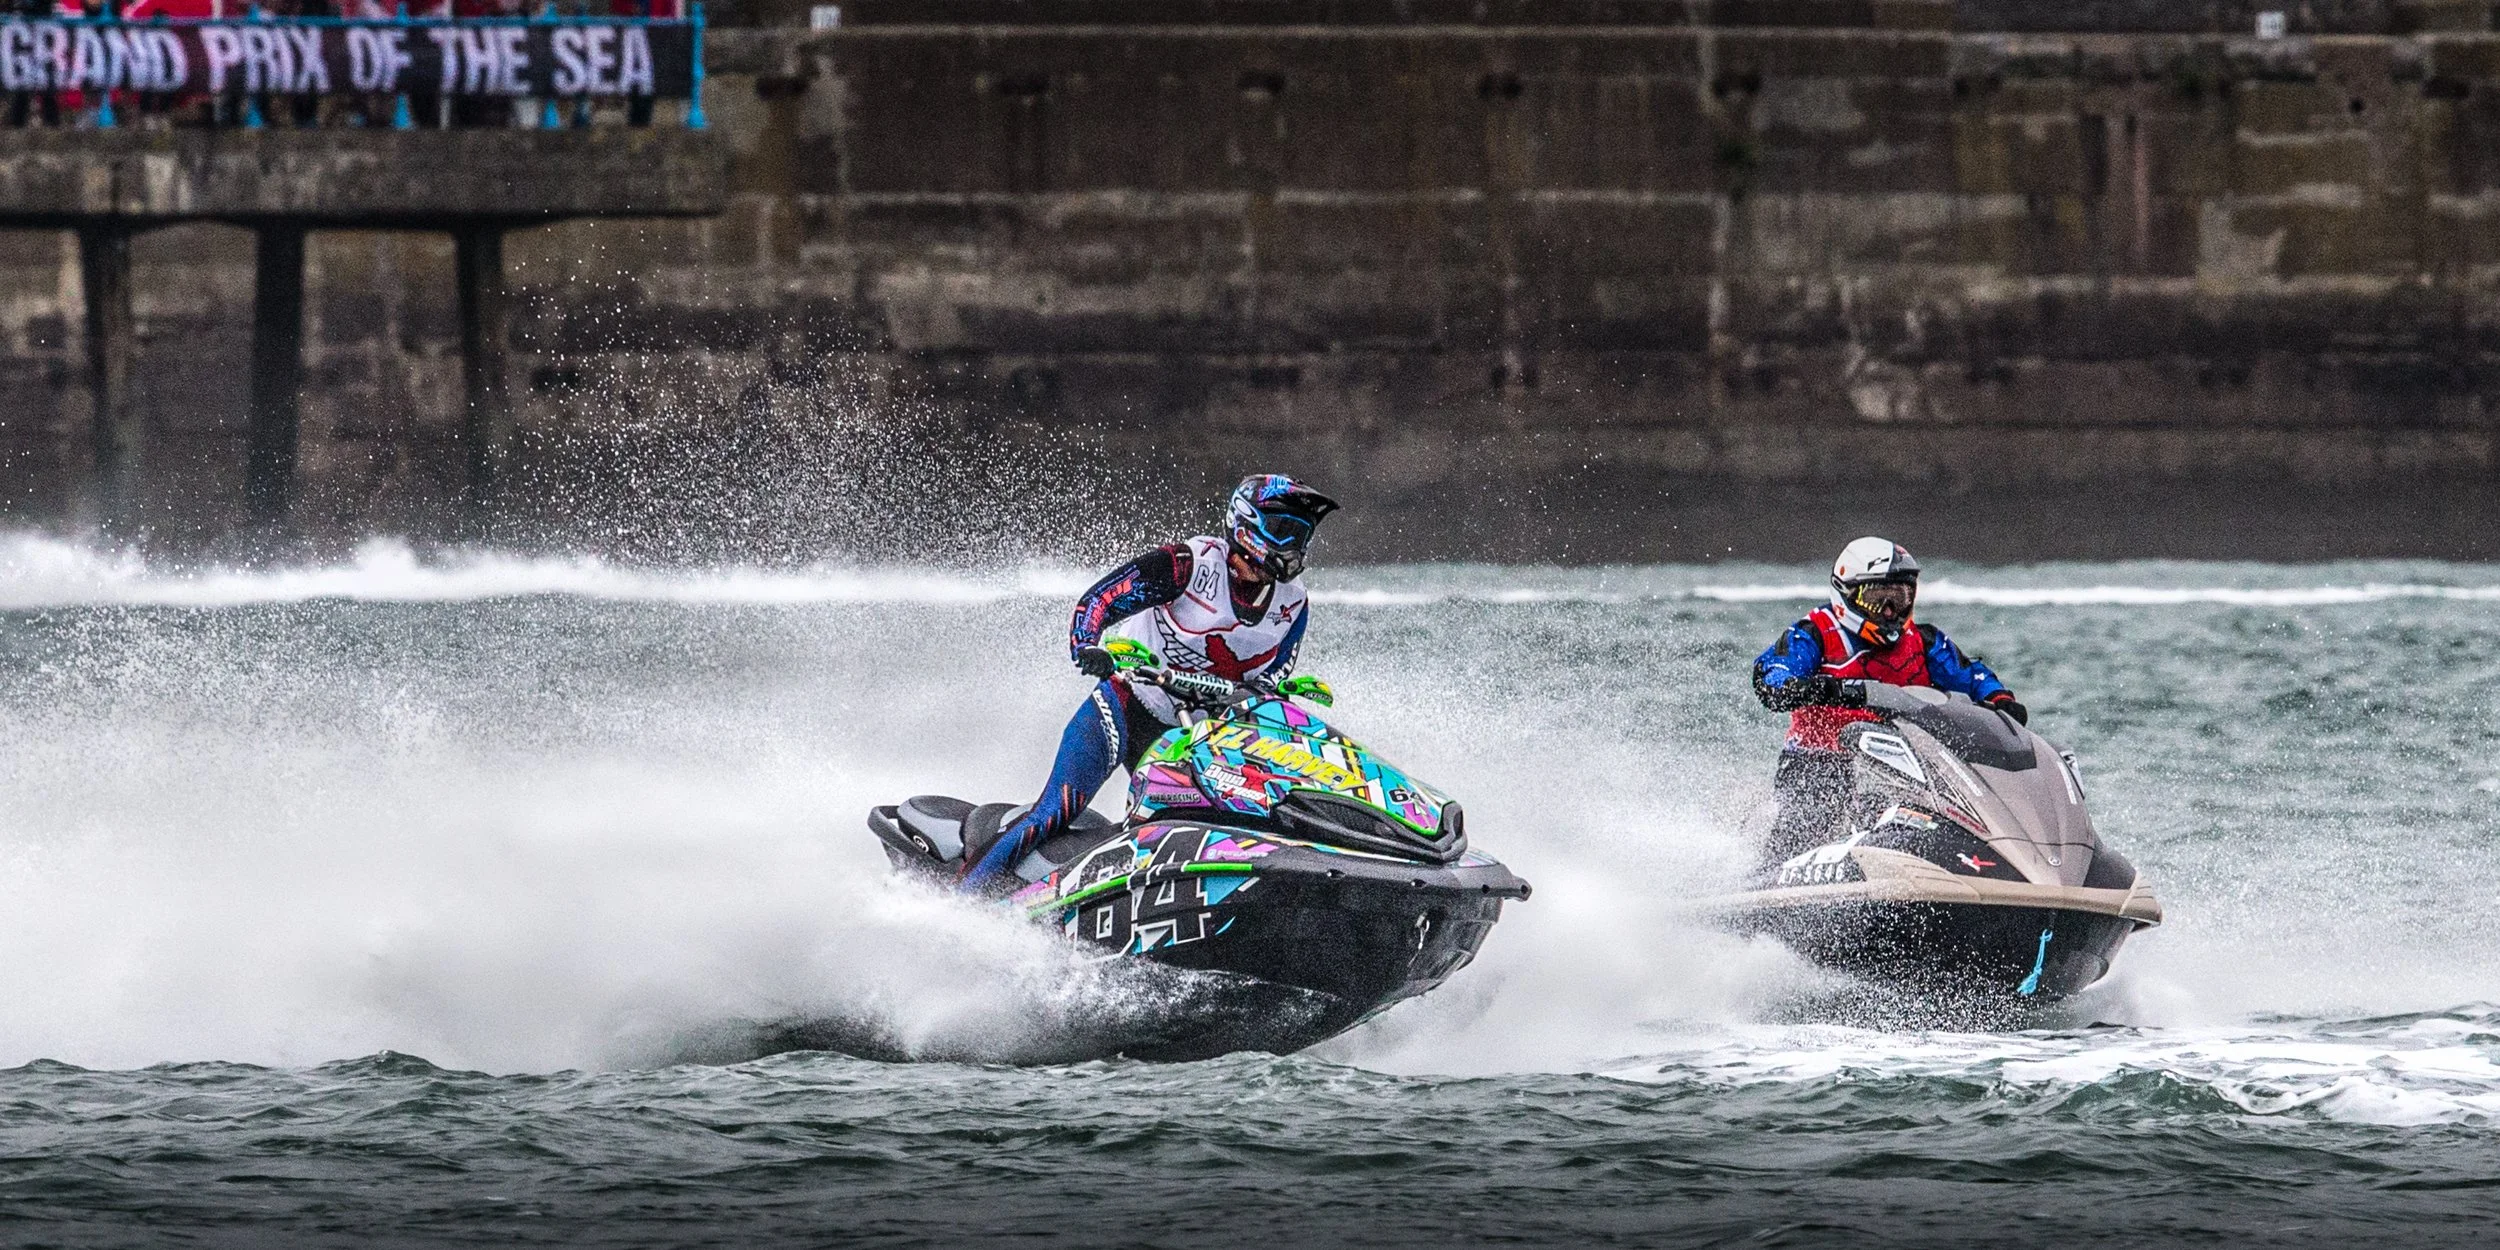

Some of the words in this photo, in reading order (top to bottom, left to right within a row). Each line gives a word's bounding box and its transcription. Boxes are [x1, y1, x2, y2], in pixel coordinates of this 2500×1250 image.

[1, 20, 188, 92] GRAND
[203, 26, 329, 93] PRIX
[347, 27, 413, 93] OF
[431, 26, 531, 94] THE
[550, 26, 654, 95] SEA
[1193, 564, 1220, 601] 64
[1173, 678, 1230, 696] RENTHAL
[1243, 736, 1367, 792] HARVEY
